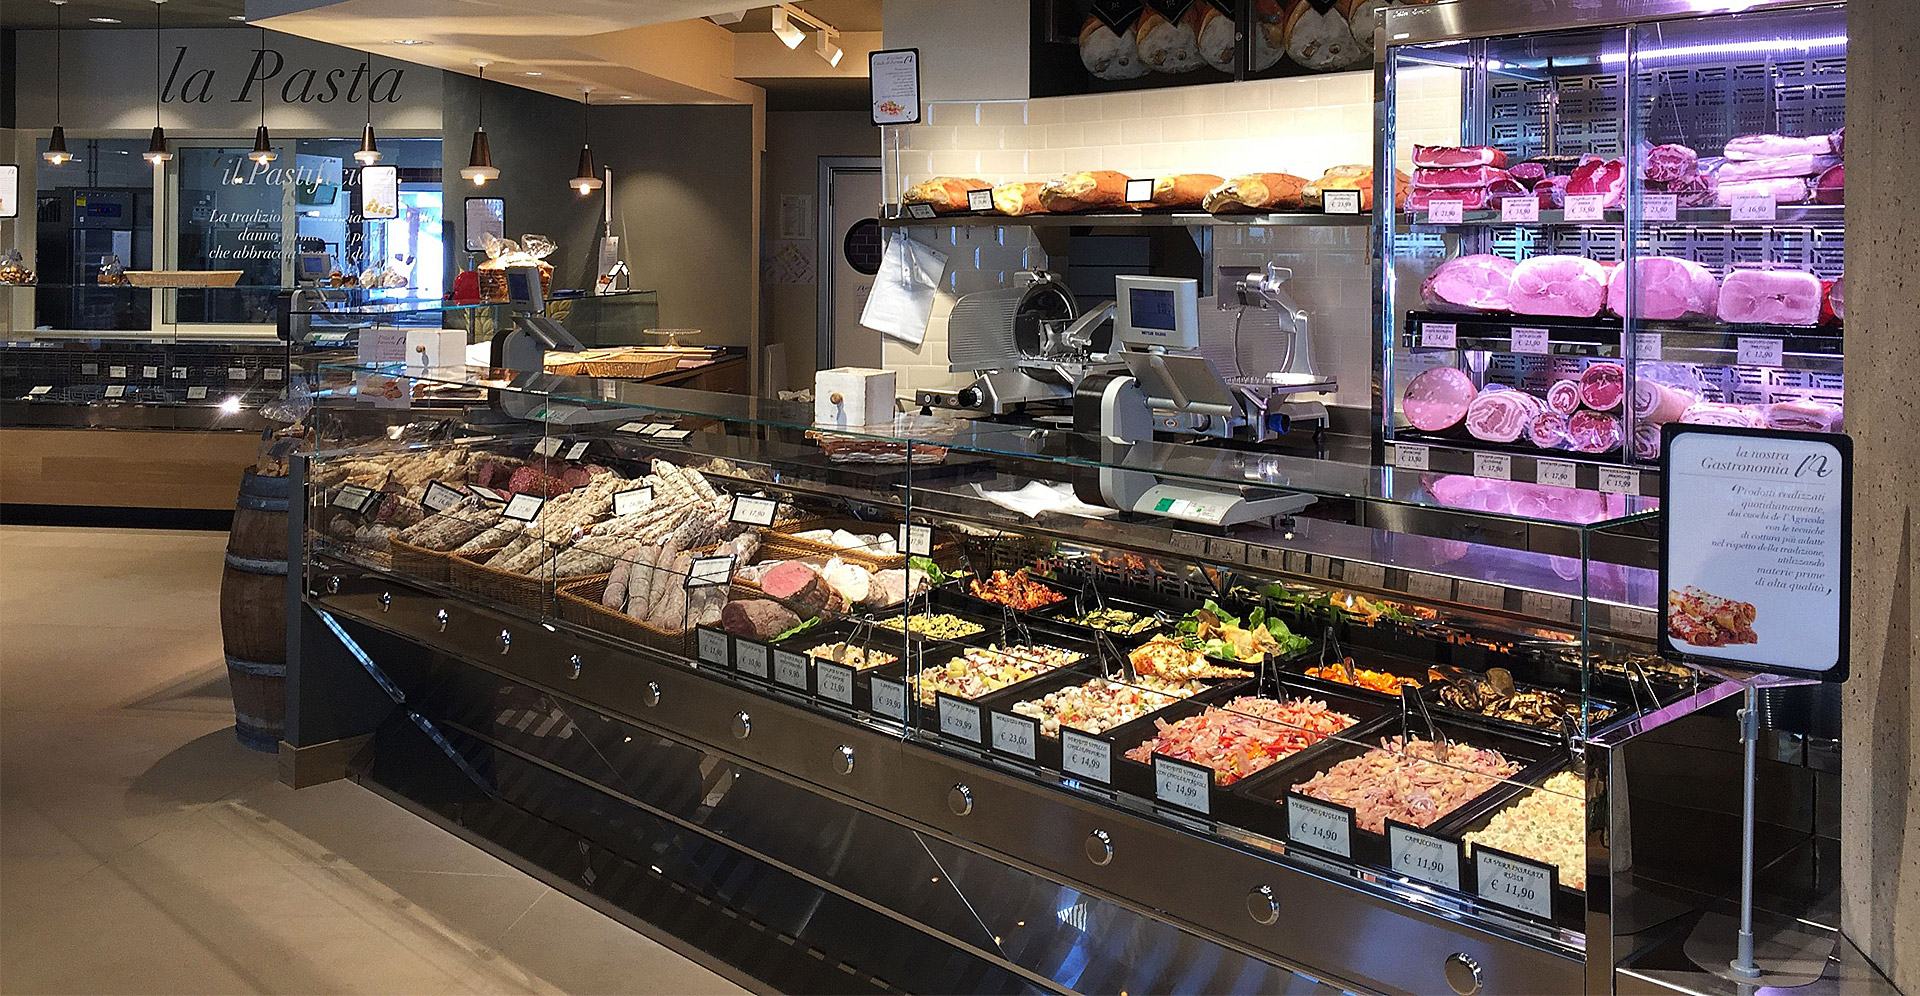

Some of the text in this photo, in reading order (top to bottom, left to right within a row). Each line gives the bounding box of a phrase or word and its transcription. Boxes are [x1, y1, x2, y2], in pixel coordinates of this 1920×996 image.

[161, 46, 405, 103] la Pasta
[222, 157, 243, 186] il
[209, 209, 227, 223] La
[1748, 206, 1767, 214] 16,90
[238, 228, 279, 243] danno
[208, 243, 231, 259] che
[1735, 446, 1790, 461] la nostra
[1701, 457, 1790, 476] Gastronomia
[1777, 488, 1826, 502] realizzati
[1727, 508, 1742, 518] dai
[1782, 524, 1791, 533] le
[1791, 525, 1826, 536] tecniche
[1740, 531, 1750, 540] di
[1751, 533, 1781, 543] cottura
[1797, 536, 1826, 546] adatte
[1711, 539, 1826, 558] nel rispetto della tradizione,
[1777, 556, 1826, 568] utilizzando
[1756, 566, 1826, 580] materie prime
[1754, 576, 1765, 587] di
[1766, 578, 1788, 589] alta
[823, 681, 828, 690] €
[878, 695, 884, 705] €
[947, 716, 973, 731] € 29,99
[1000, 731, 1028, 746] € 23,00
[1071, 753, 1101, 769] € 14,99
[1165, 781, 1197, 798] € 14,99
[1300, 822, 1338, 842] € 14,90
[1404, 835, 1443, 850] CAPRICCIOSA
[1403, 853, 1445, 873] € 11,90
[1493, 859, 1511, 870] VERA
[1510, 864, 1544, 880] INSALATA
[1504, 871, 1524, 882] RUSSA
[1491, 878, 1536, 901] € 11,90
